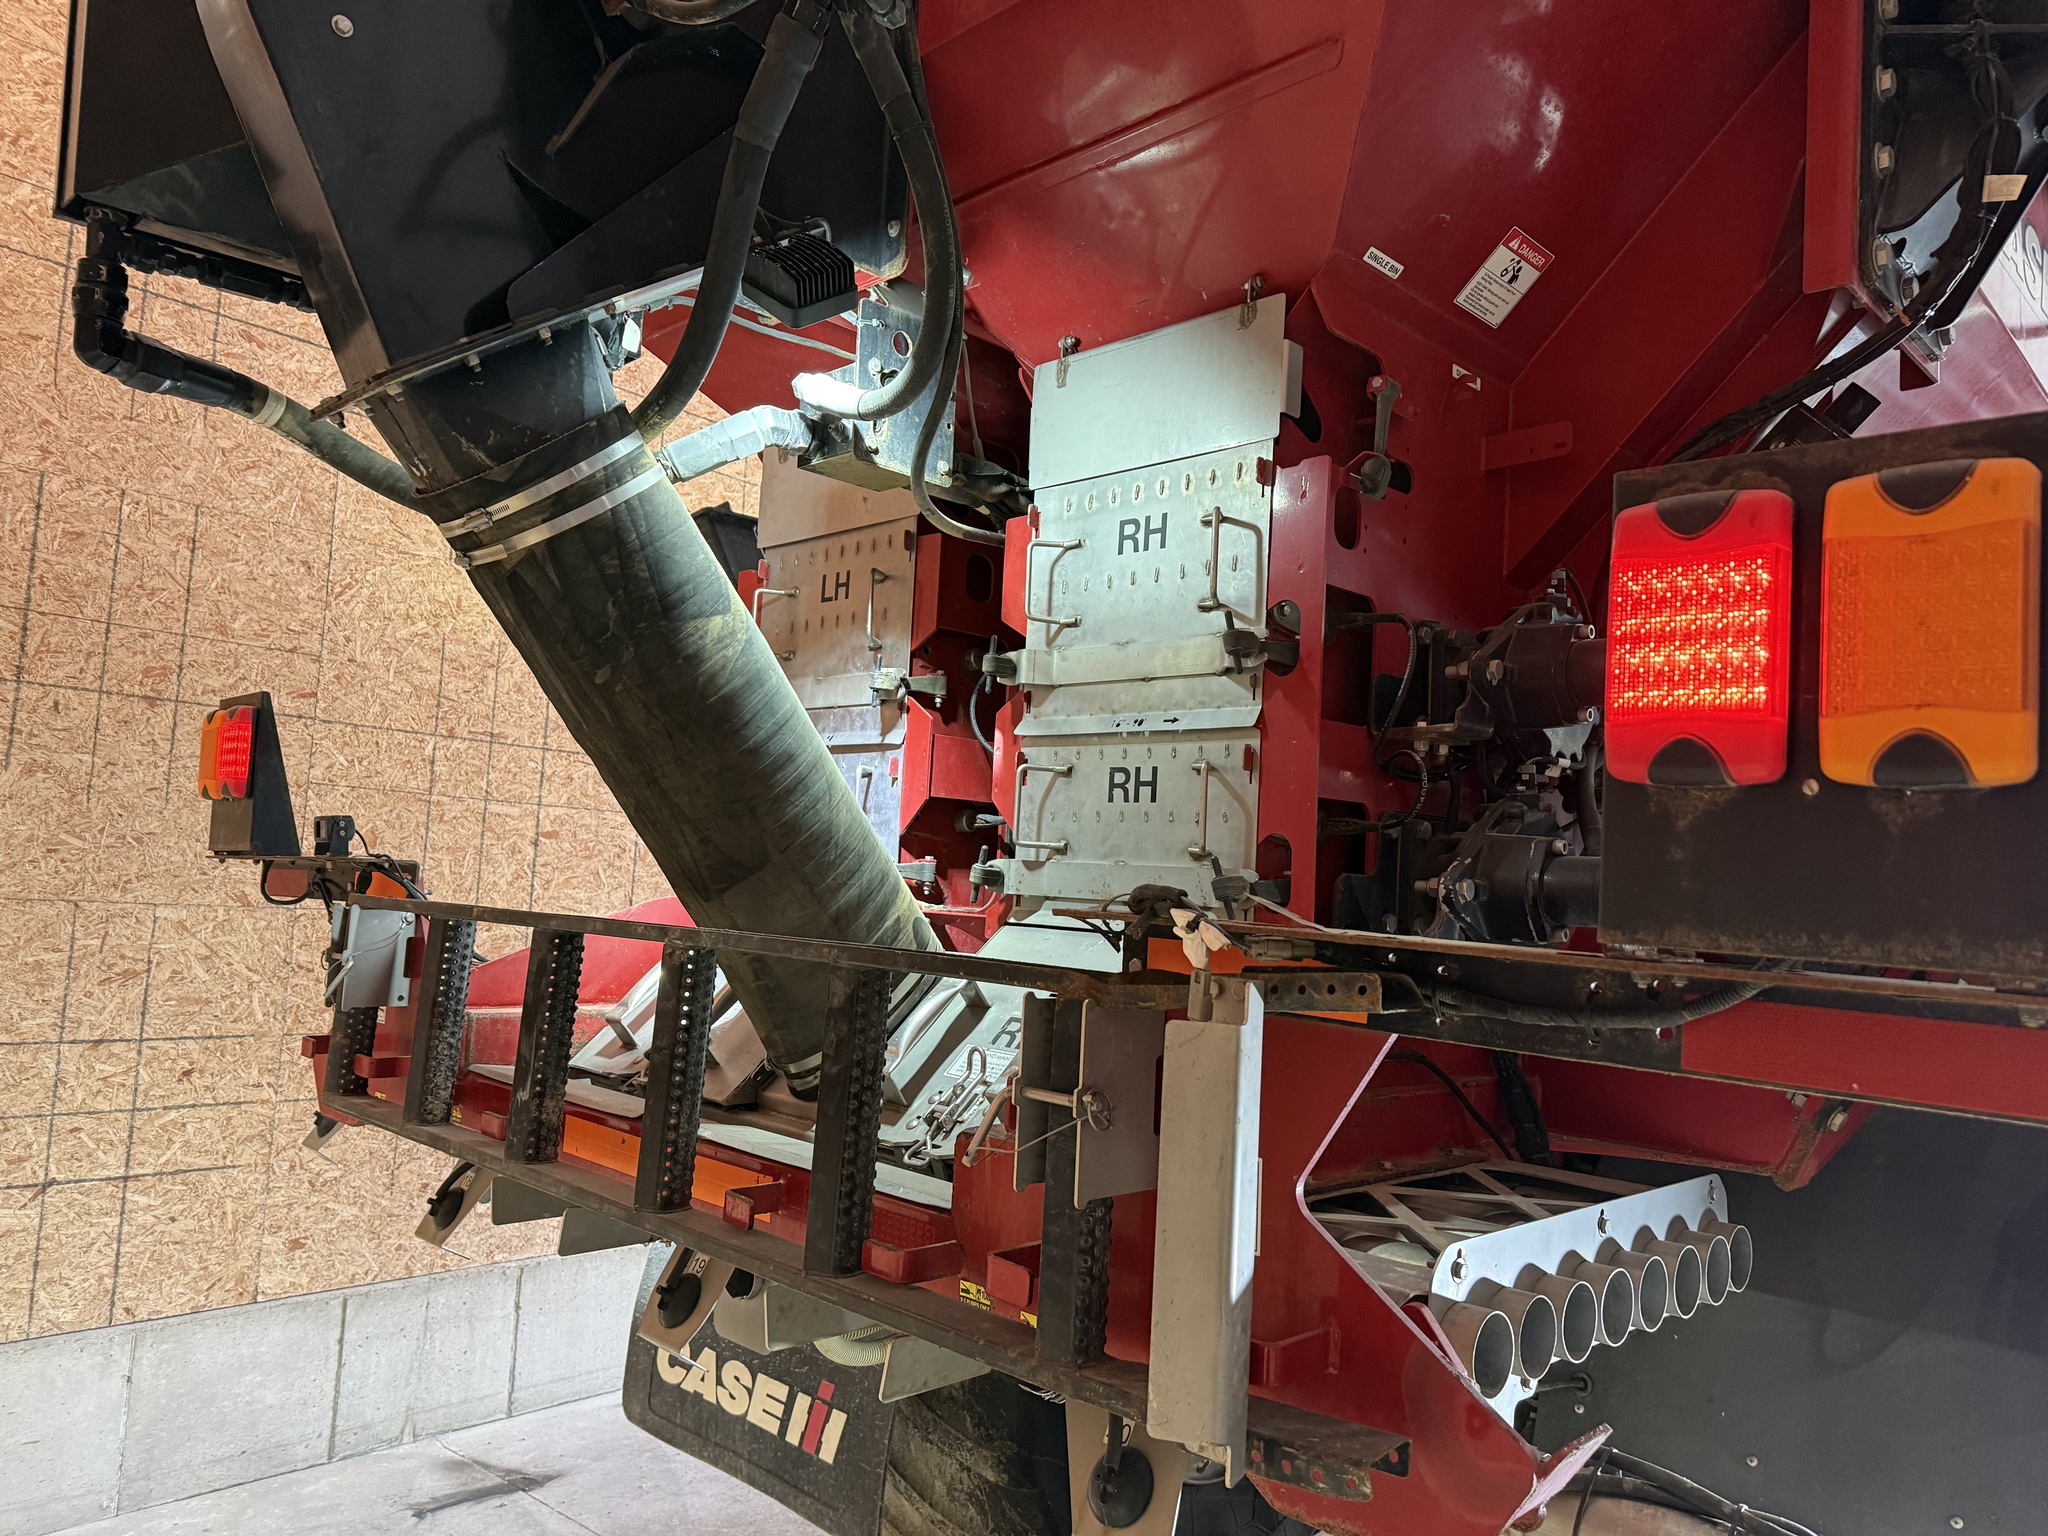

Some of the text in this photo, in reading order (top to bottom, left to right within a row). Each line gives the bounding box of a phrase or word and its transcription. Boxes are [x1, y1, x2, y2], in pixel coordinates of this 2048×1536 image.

[1367, 251, 1400, 276] SINGLE BIN
[1518, 243, 1545, 268] DANGER
[1118, 512, 1168, 555] RH
[821, 570, 850, 603] LH
[1108, 766, 1158, 803] RH
[989, 1017, 1022, 1049] R
[692, 1257, 706, 1273] 19
[657, 1347, 790, 1436] CASE
